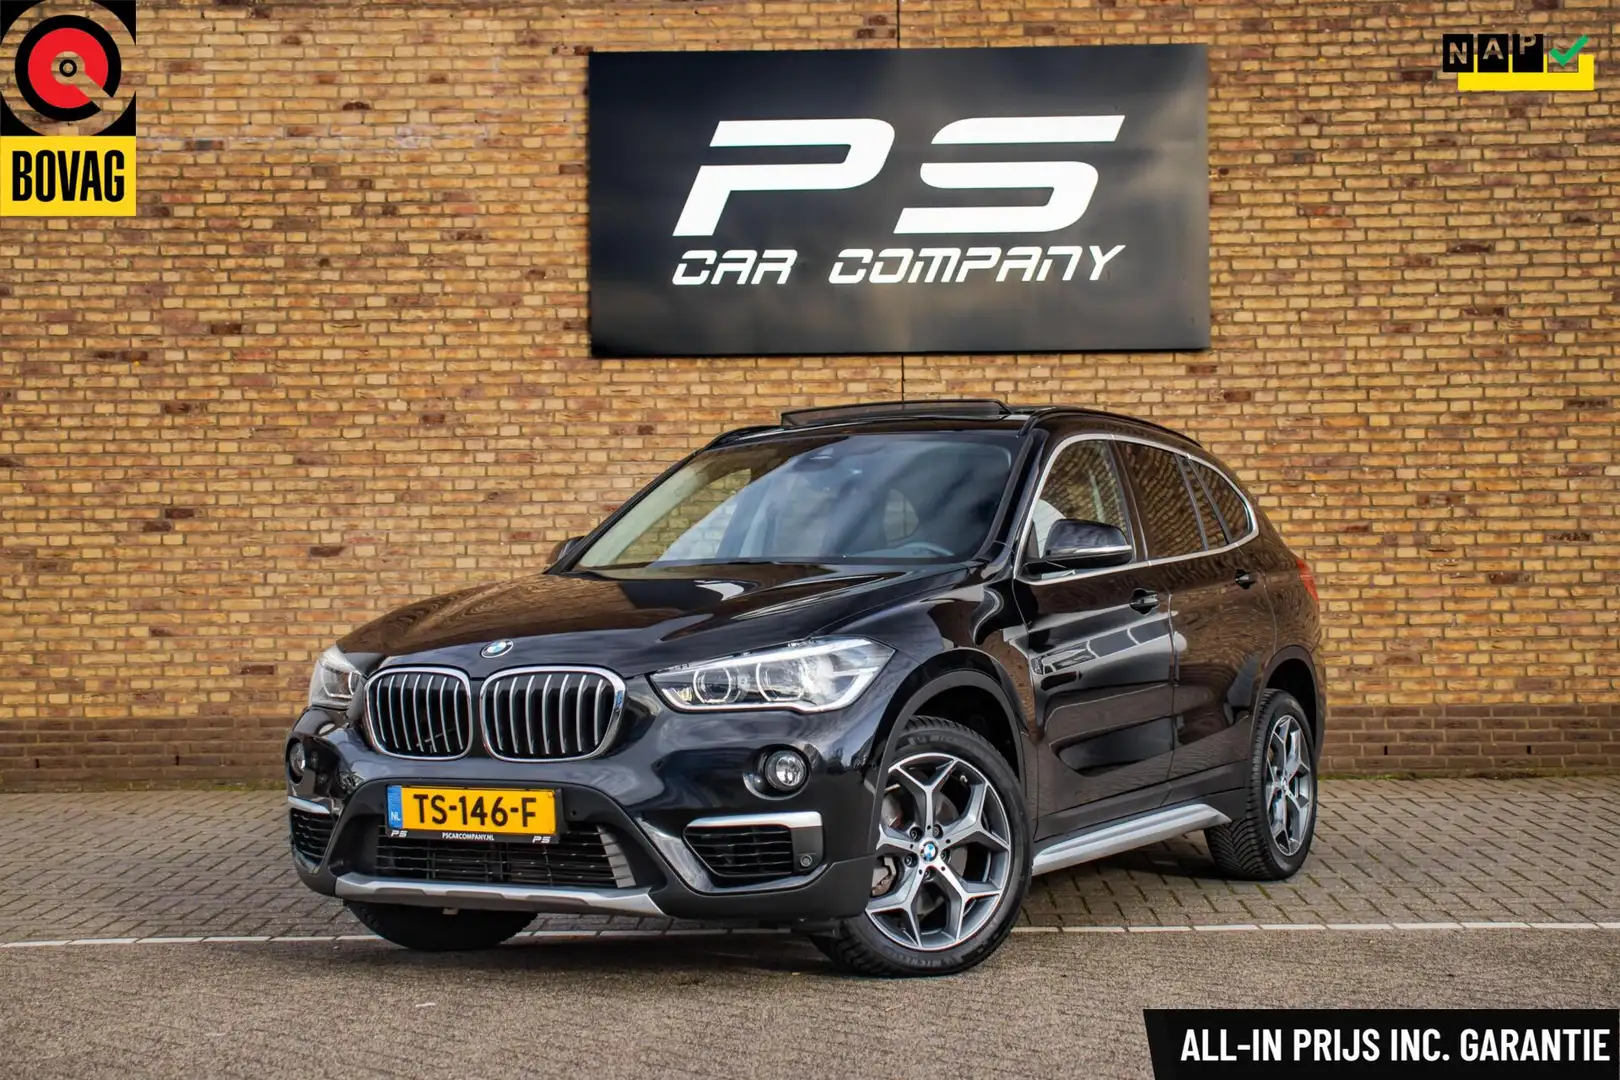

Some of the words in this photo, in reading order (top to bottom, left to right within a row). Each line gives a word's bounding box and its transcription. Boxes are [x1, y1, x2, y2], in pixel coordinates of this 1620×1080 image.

[672, 115, 1126, 236] PS
[672, 249, 798, 286] CAR
[828, 244, 1126, 284] COMPANY
[390, 811, 401, 821] NL
[413, 794, 537, 828] TS-146-F
[390, 830, 408, 838] PS
[442, 832, 495, 842] PSCARCOMPANY.NL
[532, 836, 551, 844] PS
